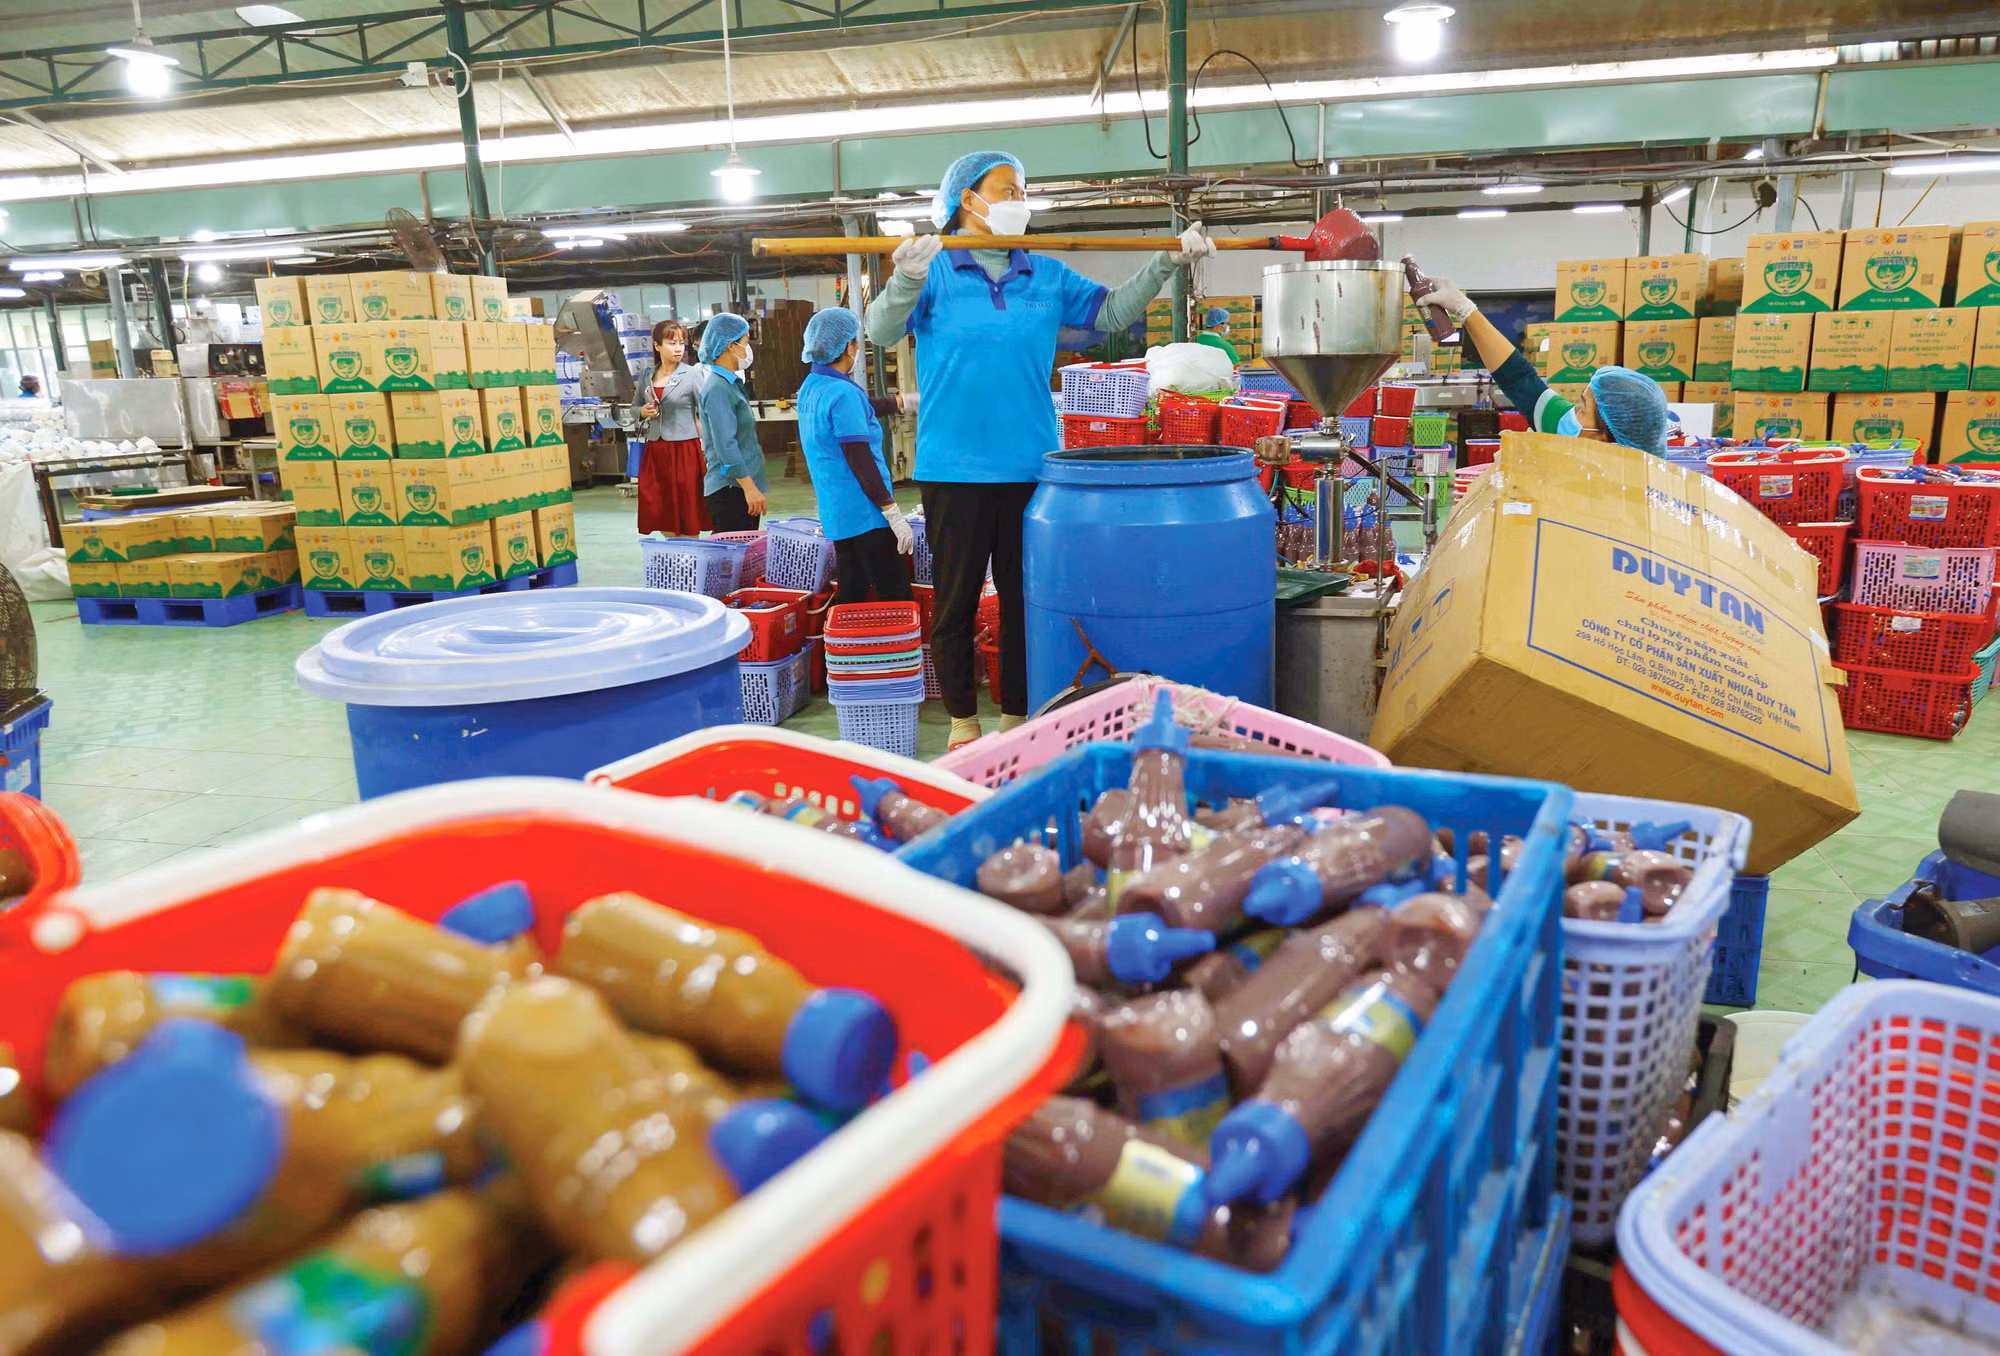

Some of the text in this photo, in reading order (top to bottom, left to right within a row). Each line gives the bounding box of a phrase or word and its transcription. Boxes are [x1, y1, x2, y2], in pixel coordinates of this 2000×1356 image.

[1612, 547, 1764, 635] DUYTAN
[1582, 618, 1610, 636] CÔNG
[1613, 630, 1626, 642] TY
[1629, 637, 1643, 650] CỔ
[1676, 655, 1696, 673] SẢN
[1699, 666, 1724, 684] XUẤT
[1727, 679, 1754, 700] NHỰA
[1757, 692, 1775, 707] DUY
[1777, 701, 1796, 719] TÂN
[1617, 619, 1768, 689] chai lọ mỹ phẩm cao cấp
[1640, 617, 1691, 644] Chuyên
[1694, 640, 1717, 654] sản
[1720, 652, 1749, 669] xuất
[1608, 641, 1624, 655] Học
[1728, 693, 1742, 704] Chí
[1767, 709, 1782, 724] Việt
[1784, 719, 1801, 732] Nam
[1632, 662, 1647, 675] 028
[1691, 688, 1708, 702] Fax:
[1711, 696, 1725, 709] 028
[1651, 683, 1724, 719] www.duytan.com
